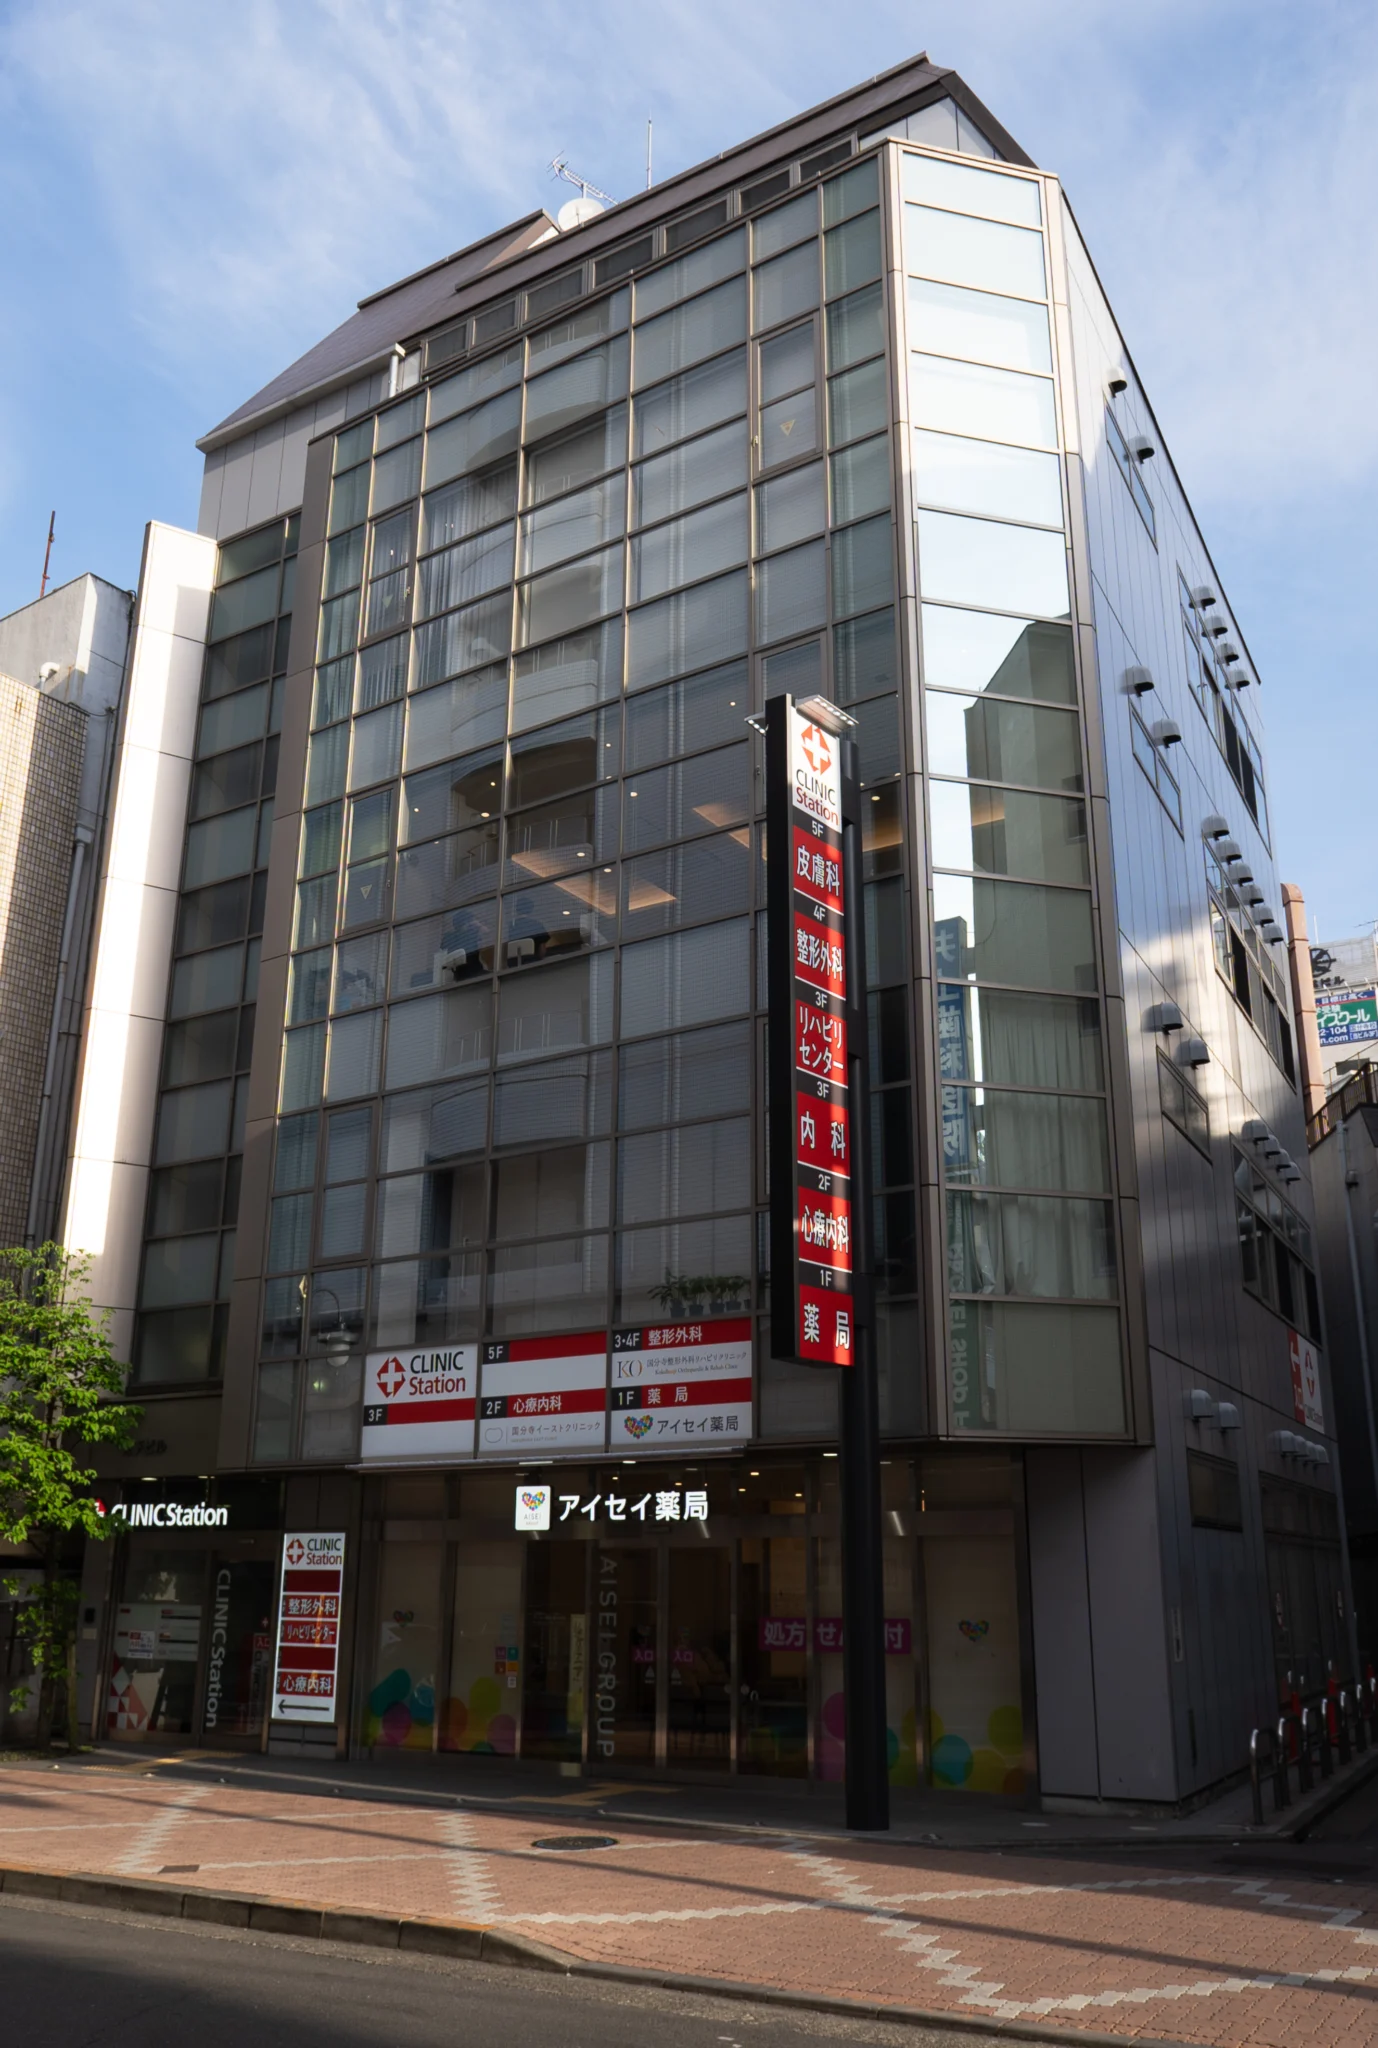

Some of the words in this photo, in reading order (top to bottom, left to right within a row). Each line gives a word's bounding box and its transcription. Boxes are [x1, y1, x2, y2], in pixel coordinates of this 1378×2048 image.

[796, 769, 836, 806] CLINIC
[796, 786, 839, 827] Station
[811, 820, 824, 837] 5F
[796, 845, 841, 896] 皮膚科
[813, 905, 826, 922] 4F
[796, 928, 843, 982] 整形外科
[815, 991, 828, 1008] 3F
[799, 1006, 842, 1049] リハビリ
[799, 1038, 844, 1074] センター
[816, 1081, 829, 1098] 3F
[818, 1174, 831, 1191] 2F
[801, 1205, 849, 1254] 心療内科
[820, 1269, 832, 1287] 1F
[648, 1325, 702, 1346] 整形外科
[488, 1346, 504, 1359] 5F
[410, 1351, 464, 1374] CLINIC
[409, 1374, 466, 1396] Station
[486, 1401, 502, 1415] 2F
[513, 1395, 562, 1414] 心療内科
[618, 1391, 634, 1406] 1F
[368, 1409, 383, 1422] 3F
[512, 1421, 600, 1436] 国分寺イーストクリニック
[657, 1415, 739, 1435] アイセイ薬局
[558, 1490, 709, 1522] アイセイ薬局
[307, 1538, 342, 1551] CLINIC
[306, 1552, 342, 1565] Station
[288, 1598, 336, 1616] 整形外科
[287, 1624, 335, 1640] リハビリセンター
[764, 1620, 905, 1649] 処方せ付
[634, 1648, 654, 1662] 入口
[673, 1649, 694, 1663] 入口
[283, 1674, 332, 1694] 心療内科
